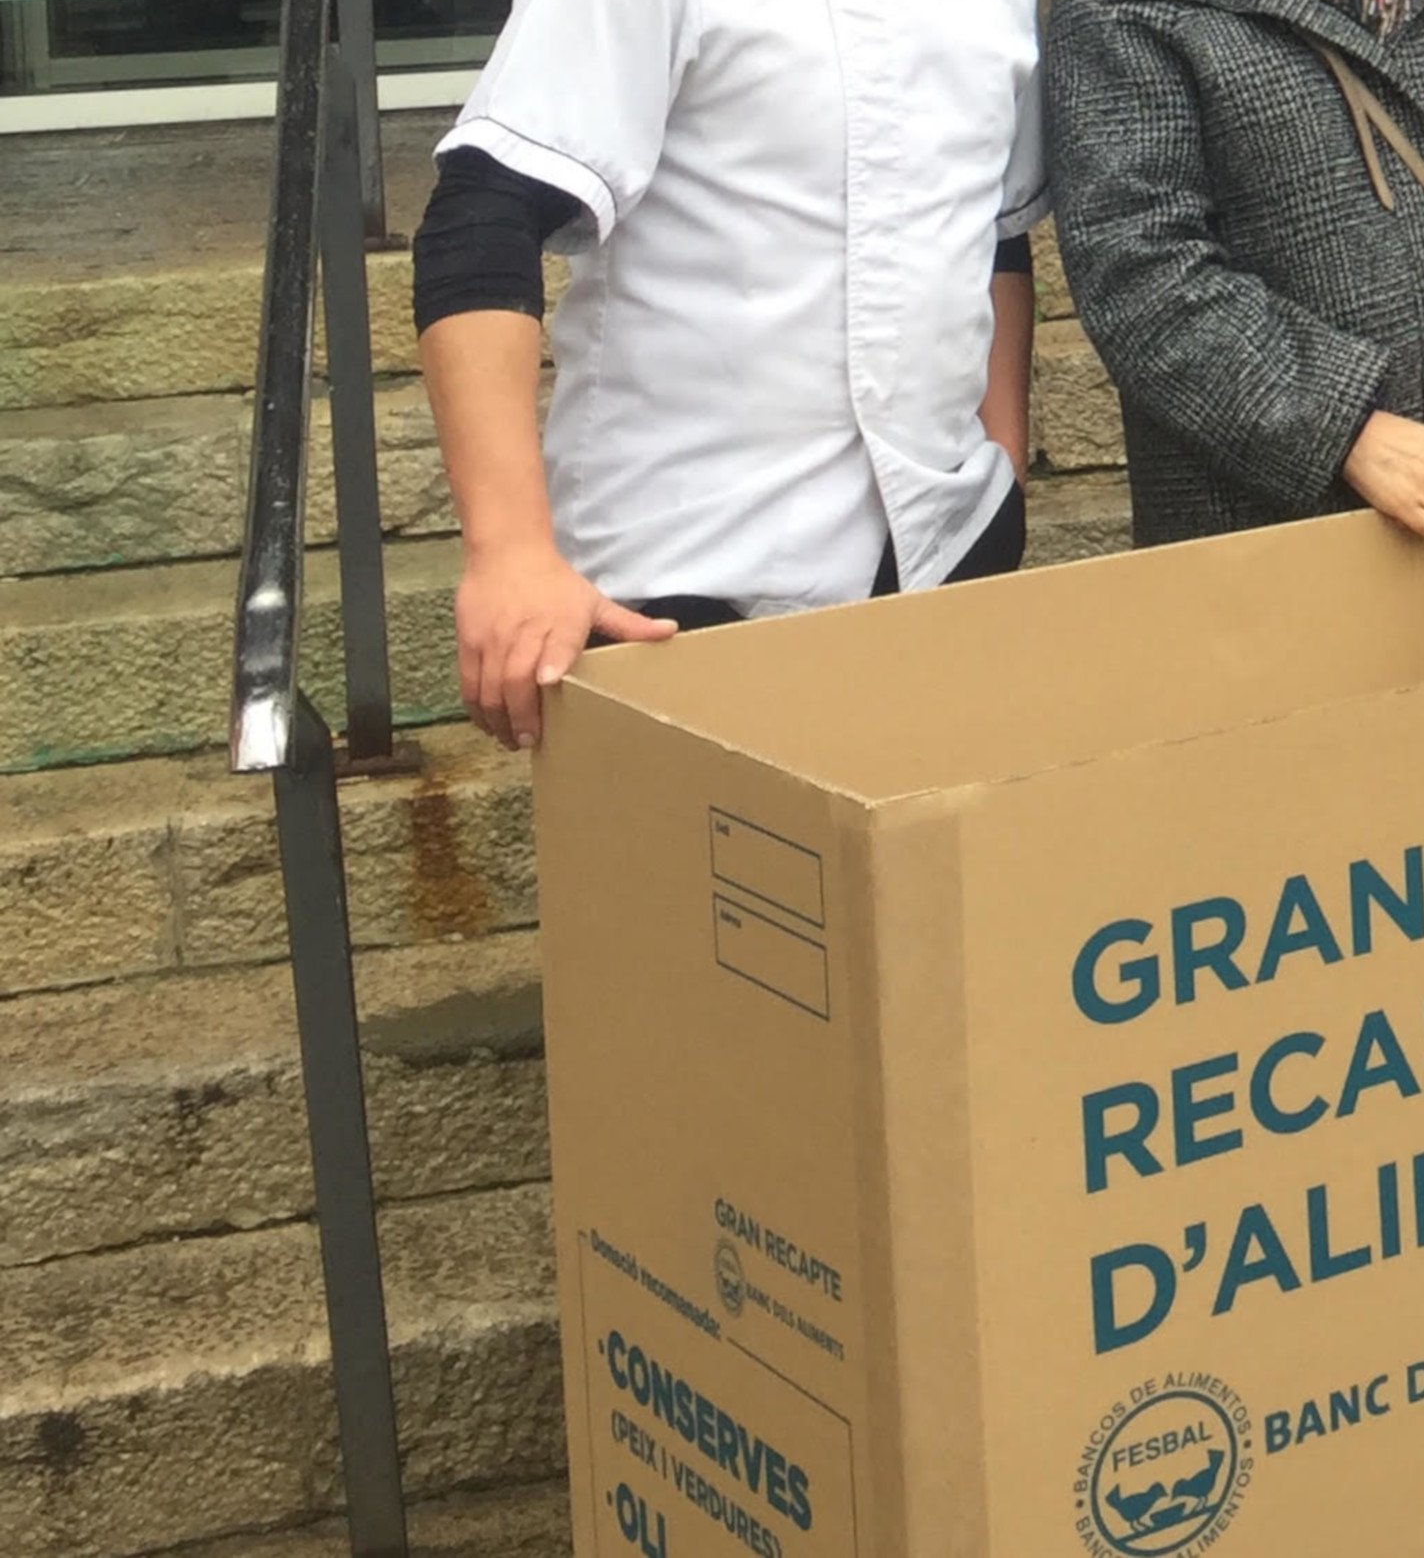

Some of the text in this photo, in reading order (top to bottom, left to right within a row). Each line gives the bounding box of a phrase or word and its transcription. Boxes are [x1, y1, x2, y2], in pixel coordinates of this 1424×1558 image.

[714, 1197, 843, 1303] GRAN RECAPTE
[796, 1312, 845, 1362] ALIMENTS
[606, 1329, 812, 1532] CONSERVES
[1073, 1371, 1252, 1493] BANCOS DE ALIMENTOS
[1111, 1421, 1214, 1473] FESBAL
[1263, 1376, 1391, 1456] BANC
[611, 1408, 658, 1473] (PEIX
[671, 1455, 782, 1558] VERDURES)
